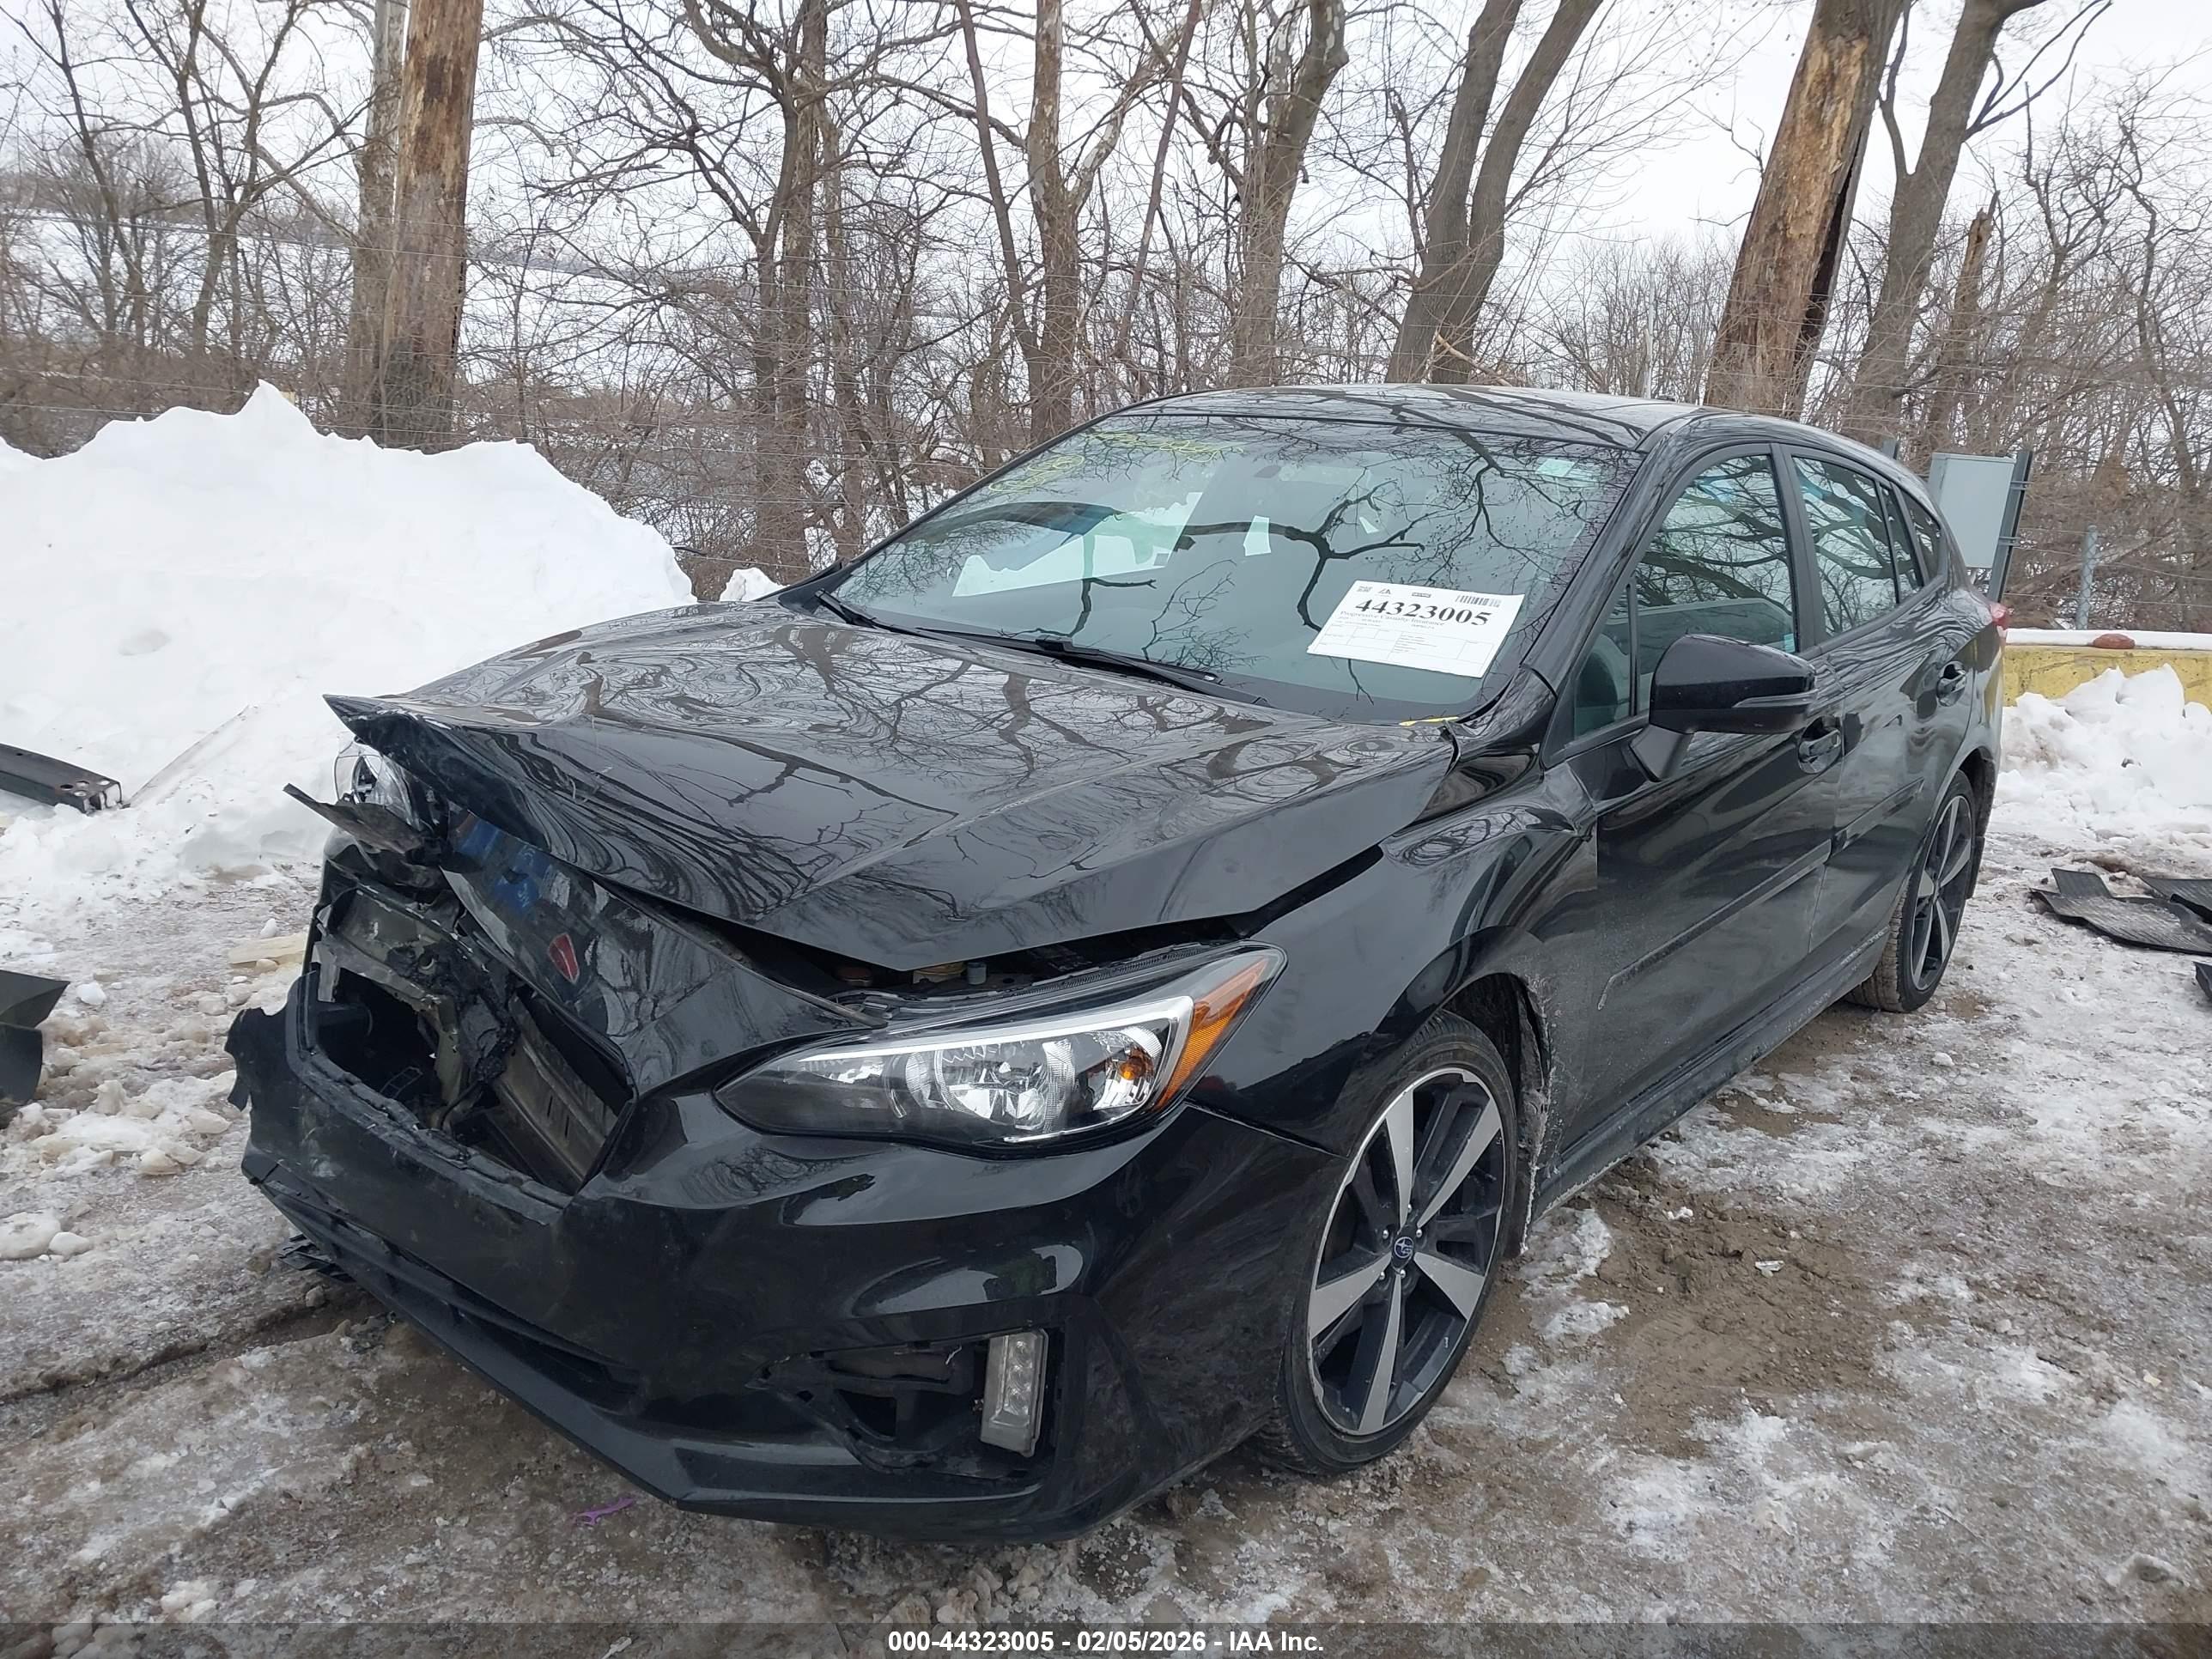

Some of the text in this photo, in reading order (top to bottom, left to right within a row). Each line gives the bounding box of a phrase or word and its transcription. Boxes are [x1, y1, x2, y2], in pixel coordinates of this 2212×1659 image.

[1340, 611, 1377, 619] Progressive
[1380, 614, 1409, 623] Casualty
[1412, 617, 1445, 626] Insurance
[1355, 599, 1493, 626] 44323005
